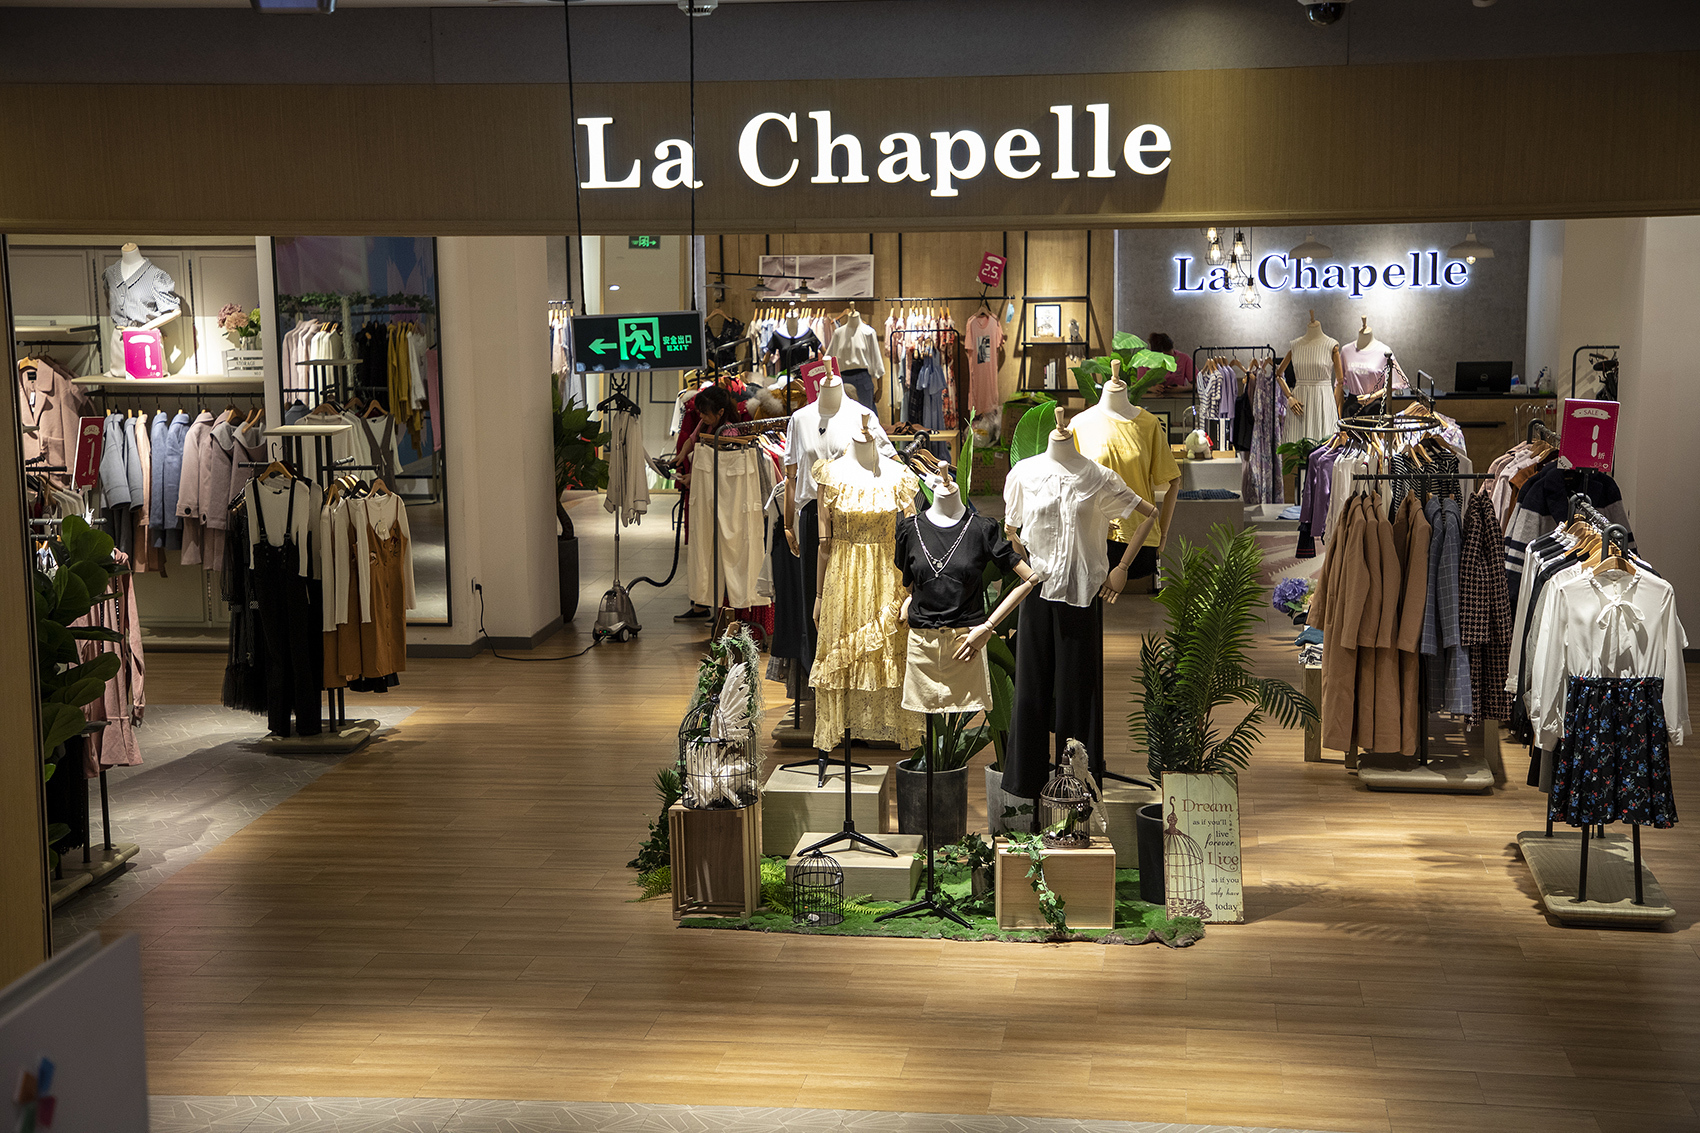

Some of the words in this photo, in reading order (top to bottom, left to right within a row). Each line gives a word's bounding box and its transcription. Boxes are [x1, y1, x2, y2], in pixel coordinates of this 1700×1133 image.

[577, 116, 704, 190] La
[738, 103, 1172, 197] Chapelle
[1173, 256, 1232, 292] La
[1257, 251, 1468, 298] Chapelle
[662, 335, 692, 345] 安全出口
[666, 344, 689, 352] EXIT
[1181, 798, 1234, 813] Dream
[1201, 818, 1207, 826] if
[1207, 819, 1227, 828] you'll
[1215, 830, 1229, 838] live
[1208, 851, 1239, 873] Live
[1219, 876, 1226, 884] if
[1226, 878, 1240, 887] you
[1210, 888, 1224, 899] only
[1225, 888, 1240, 896] have
[1215, 903, 1238, 914] today
